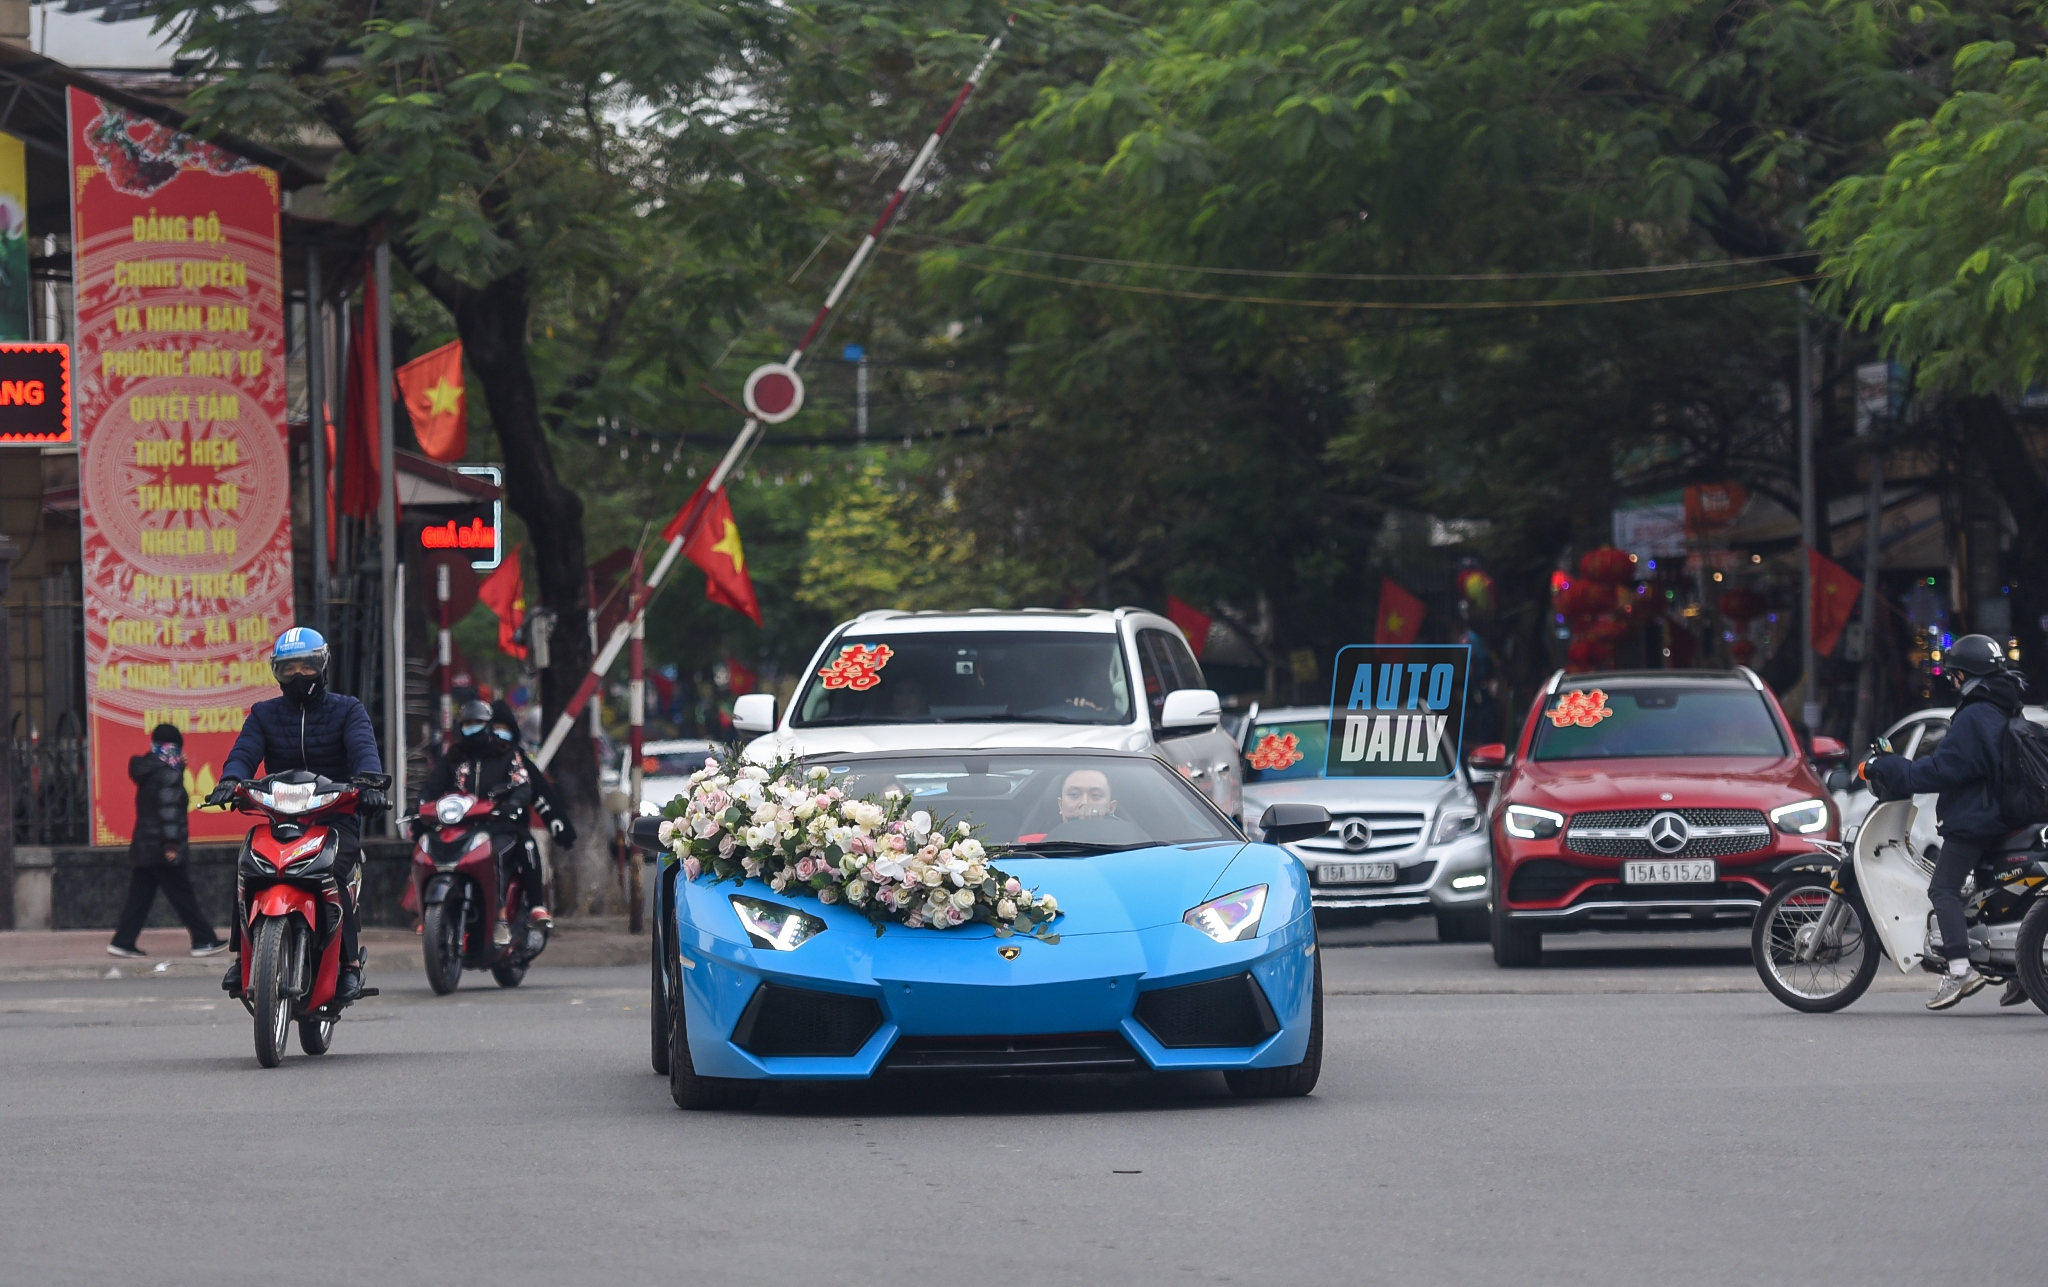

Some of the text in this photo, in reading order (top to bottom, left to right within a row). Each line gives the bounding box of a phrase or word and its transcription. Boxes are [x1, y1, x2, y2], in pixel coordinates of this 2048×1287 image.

[133, 208, 188, 243] ĐẢNG
[114, 254, 247, 290] CHÍNH QUYỀN
[115, 300, 249, 332] VÀ NHÂN DÂN
[102, 345, 263, 377] PHƯỜNG MÁY TƠ
[0, 380, 45, 405] NG
[130, 388, 239, 424] QUYẾT TÂM
[135, 434, 238, 472] THỰC HIỆN
[137, 475, 239, 516] THẮNG LỢI
[141, 524, 237, 560] NHIỆM VỤ
[133, 564, 247, 601] PHÁT TRIỂN
[108, 619, 156, 646] KINH
[162, 611, 184, 645] TẾ
[97, 664, 121, 691] AN
[229, 656, 278, 687] PHÒN
[144, 704, 244, 735] NĂM 2020
[1631, 864, 1712, 881] 15A-615.29
